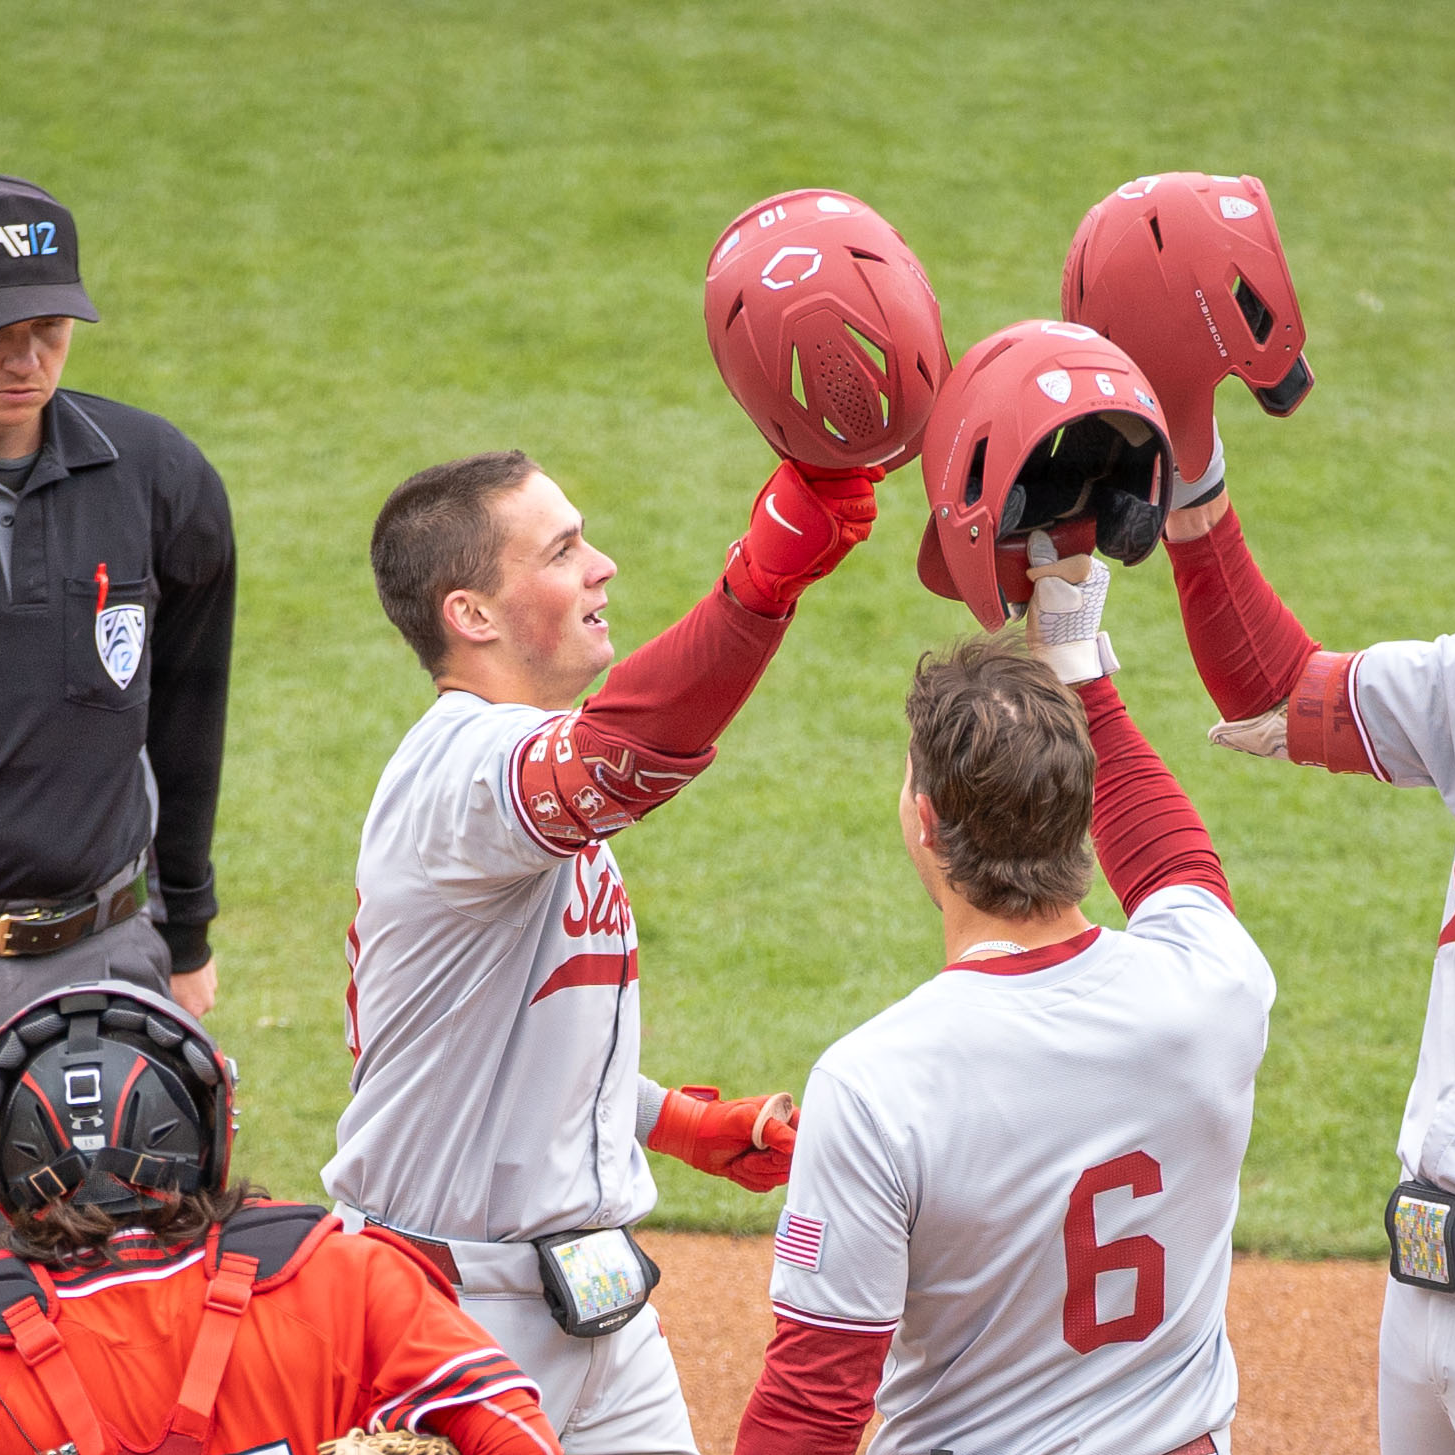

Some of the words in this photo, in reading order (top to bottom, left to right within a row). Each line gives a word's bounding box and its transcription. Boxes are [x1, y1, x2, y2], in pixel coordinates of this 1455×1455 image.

[1195, 289, 1228, 358] EVOSHIELD
[1095, 373, 1116, 397] 6
[114, 650, 133, 673] 12
[1062, 1150, 1166, 1355] 6
